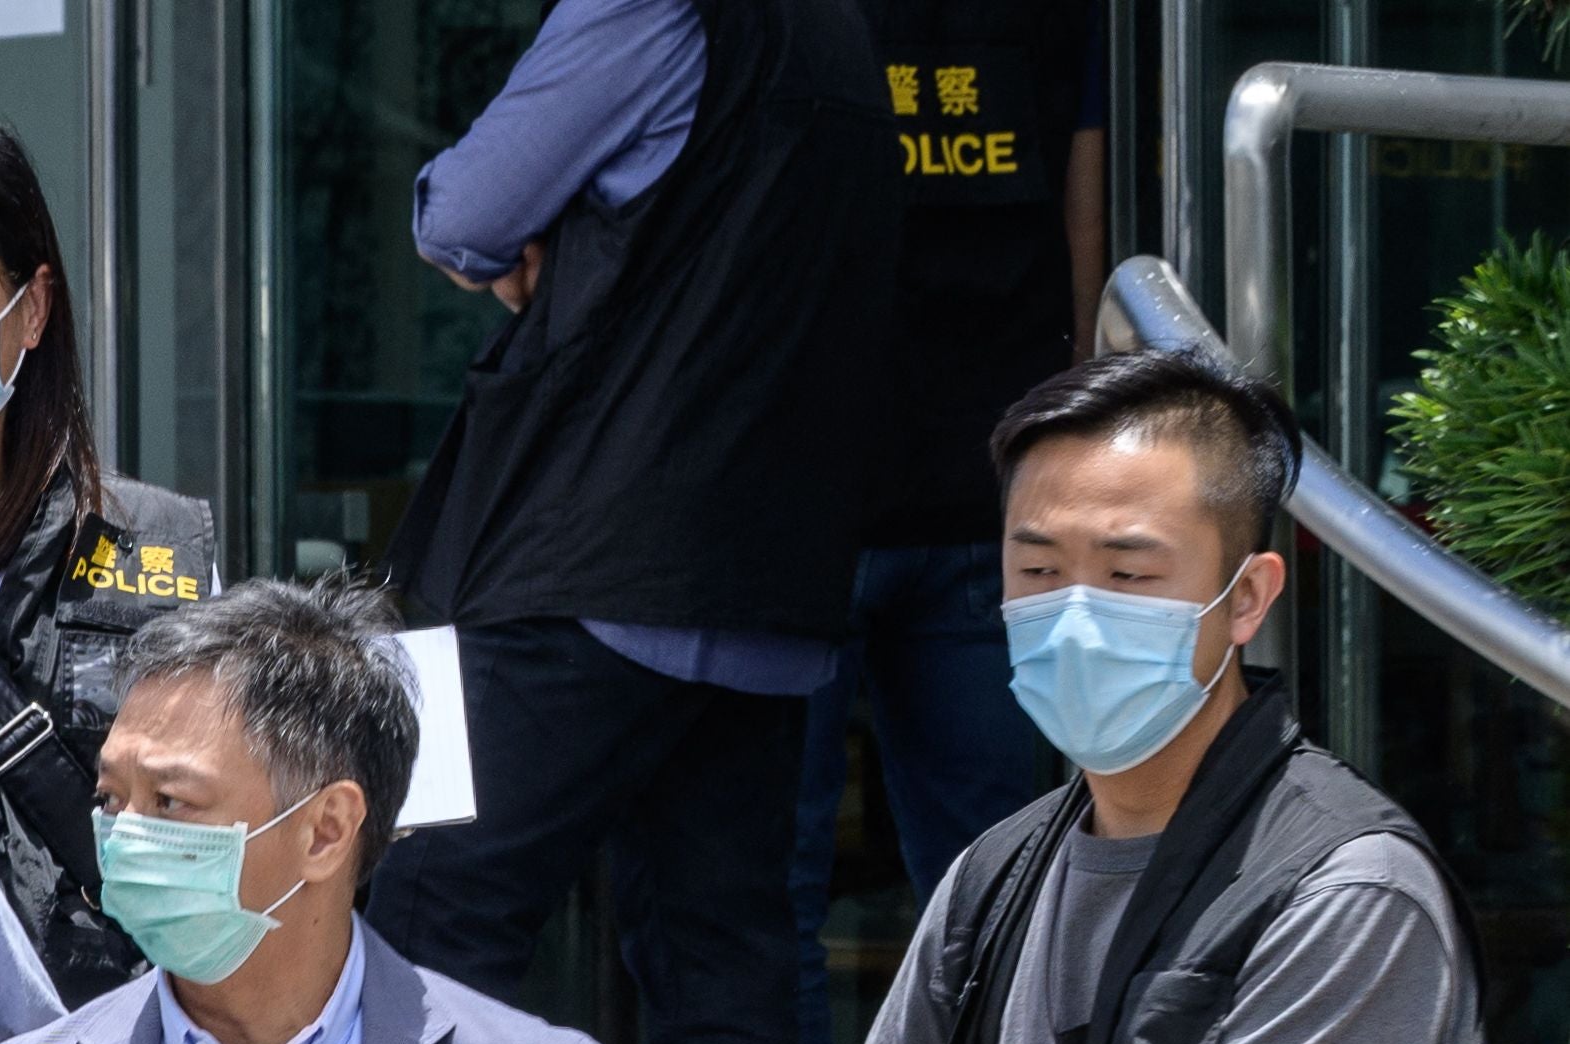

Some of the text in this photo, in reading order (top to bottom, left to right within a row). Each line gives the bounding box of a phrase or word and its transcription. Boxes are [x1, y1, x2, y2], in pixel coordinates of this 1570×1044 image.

[886, 65, 979, 115] 警察
[899, 132, 1017, 175] OLICE
[91, 535, 174, 574] 警察
[71, 556, 199, 601] POLICE
